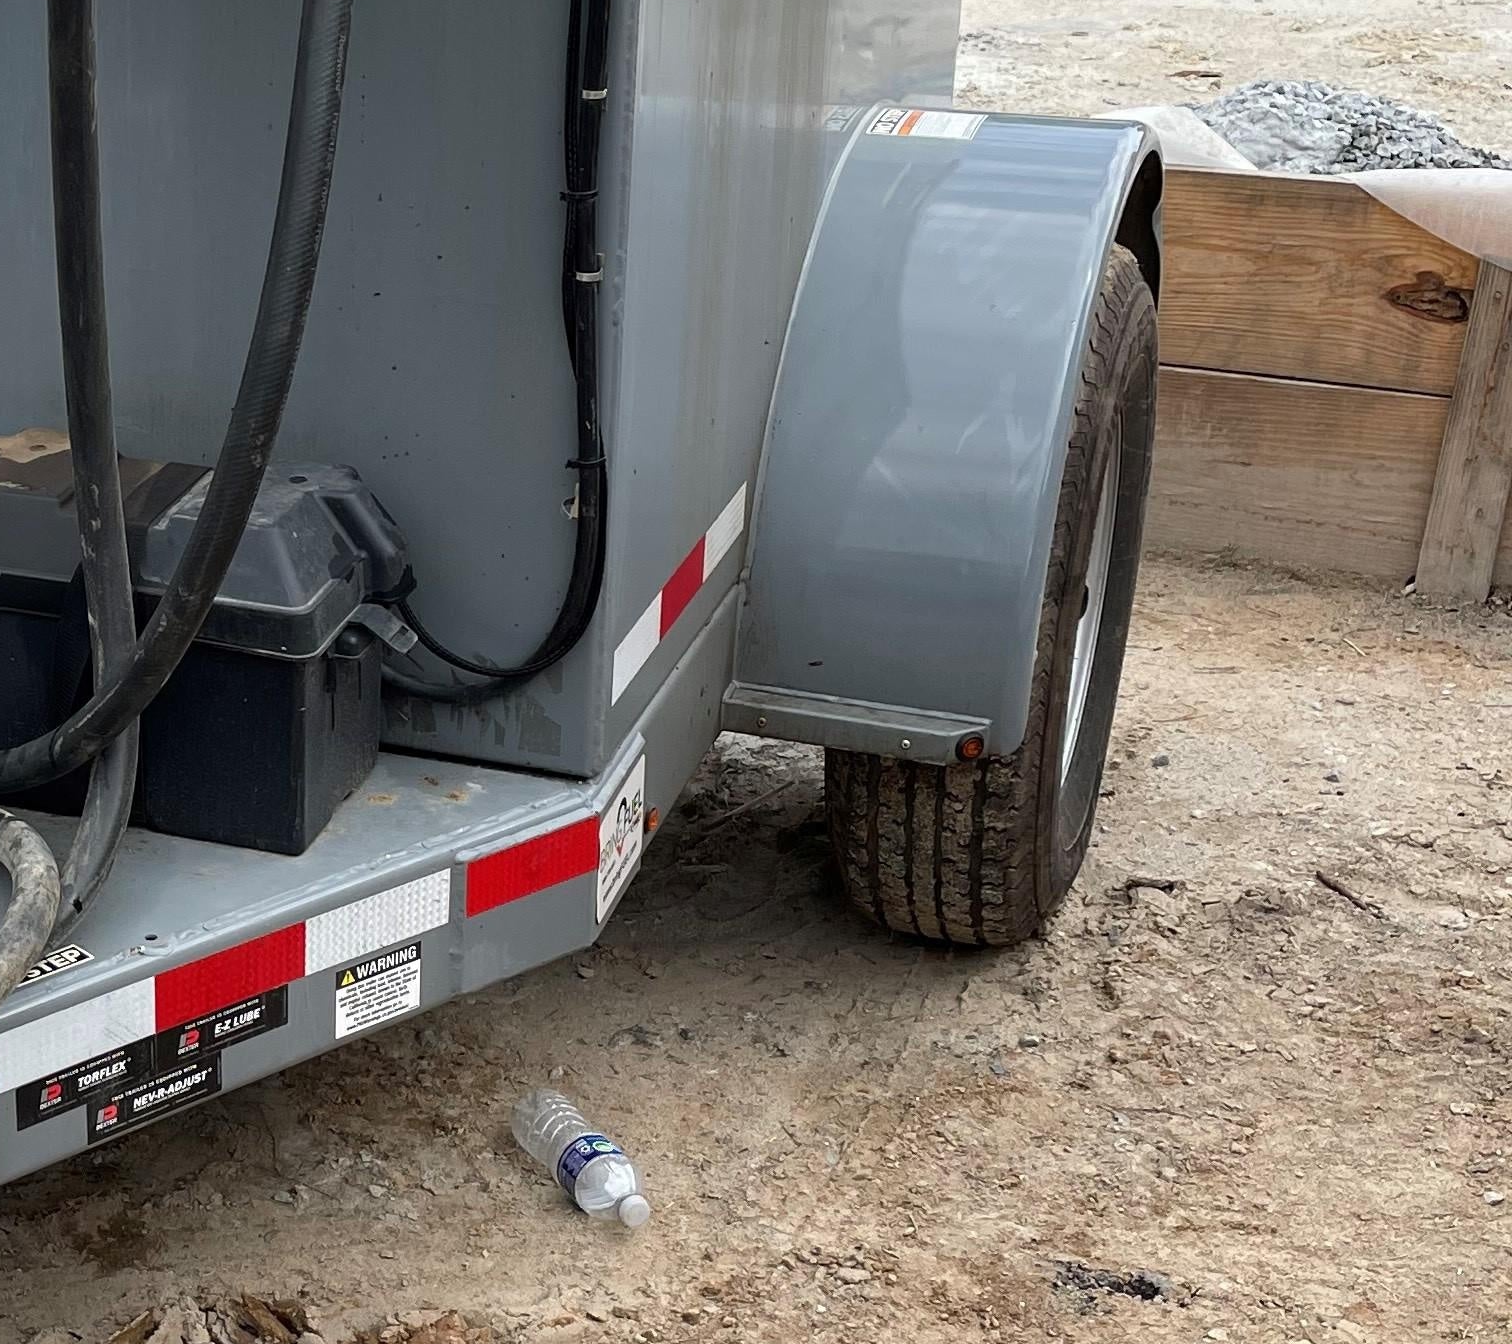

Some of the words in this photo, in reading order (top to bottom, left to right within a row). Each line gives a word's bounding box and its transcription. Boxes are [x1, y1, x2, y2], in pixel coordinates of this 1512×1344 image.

[356, 945, 417, 979] WARNING
[214, 1018, 232, 1035] E-Z
[233, 1008, 261, 1027] LUBE
[77, 1059, 127, 1088] TORFLEX
[133, 1069, 208, 1109] NEV-R-ADJUST
